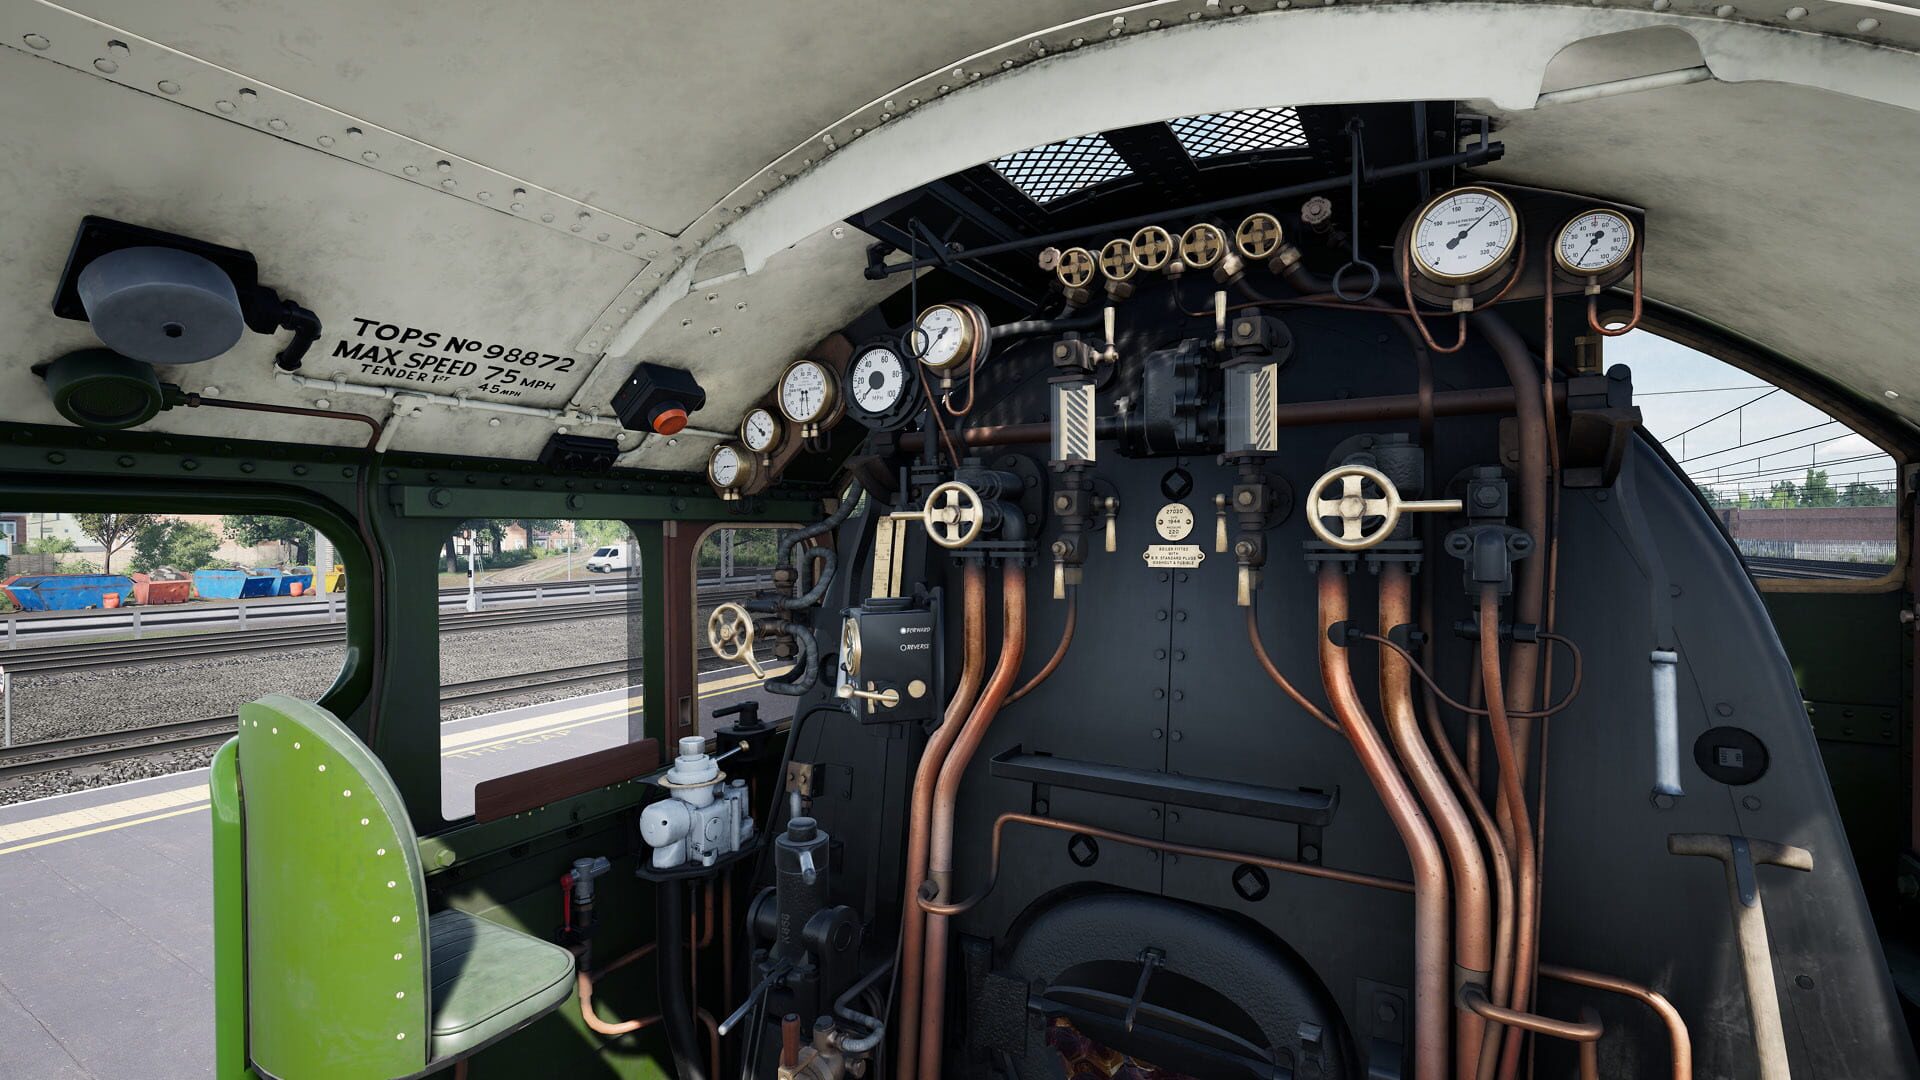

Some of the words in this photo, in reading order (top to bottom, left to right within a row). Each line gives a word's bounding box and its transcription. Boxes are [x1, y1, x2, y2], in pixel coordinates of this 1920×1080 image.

[353, 317, 442, 348] TOPS
[483, 344, 575, 372] 98872
[332, 340, 404, 366] MAX
[404, 352, 478, 376] SPEED
[520, 378, 556, 390] MPH
[362, 364, 428, 382] TENDER
[515, 730, 572, 744] GAP
